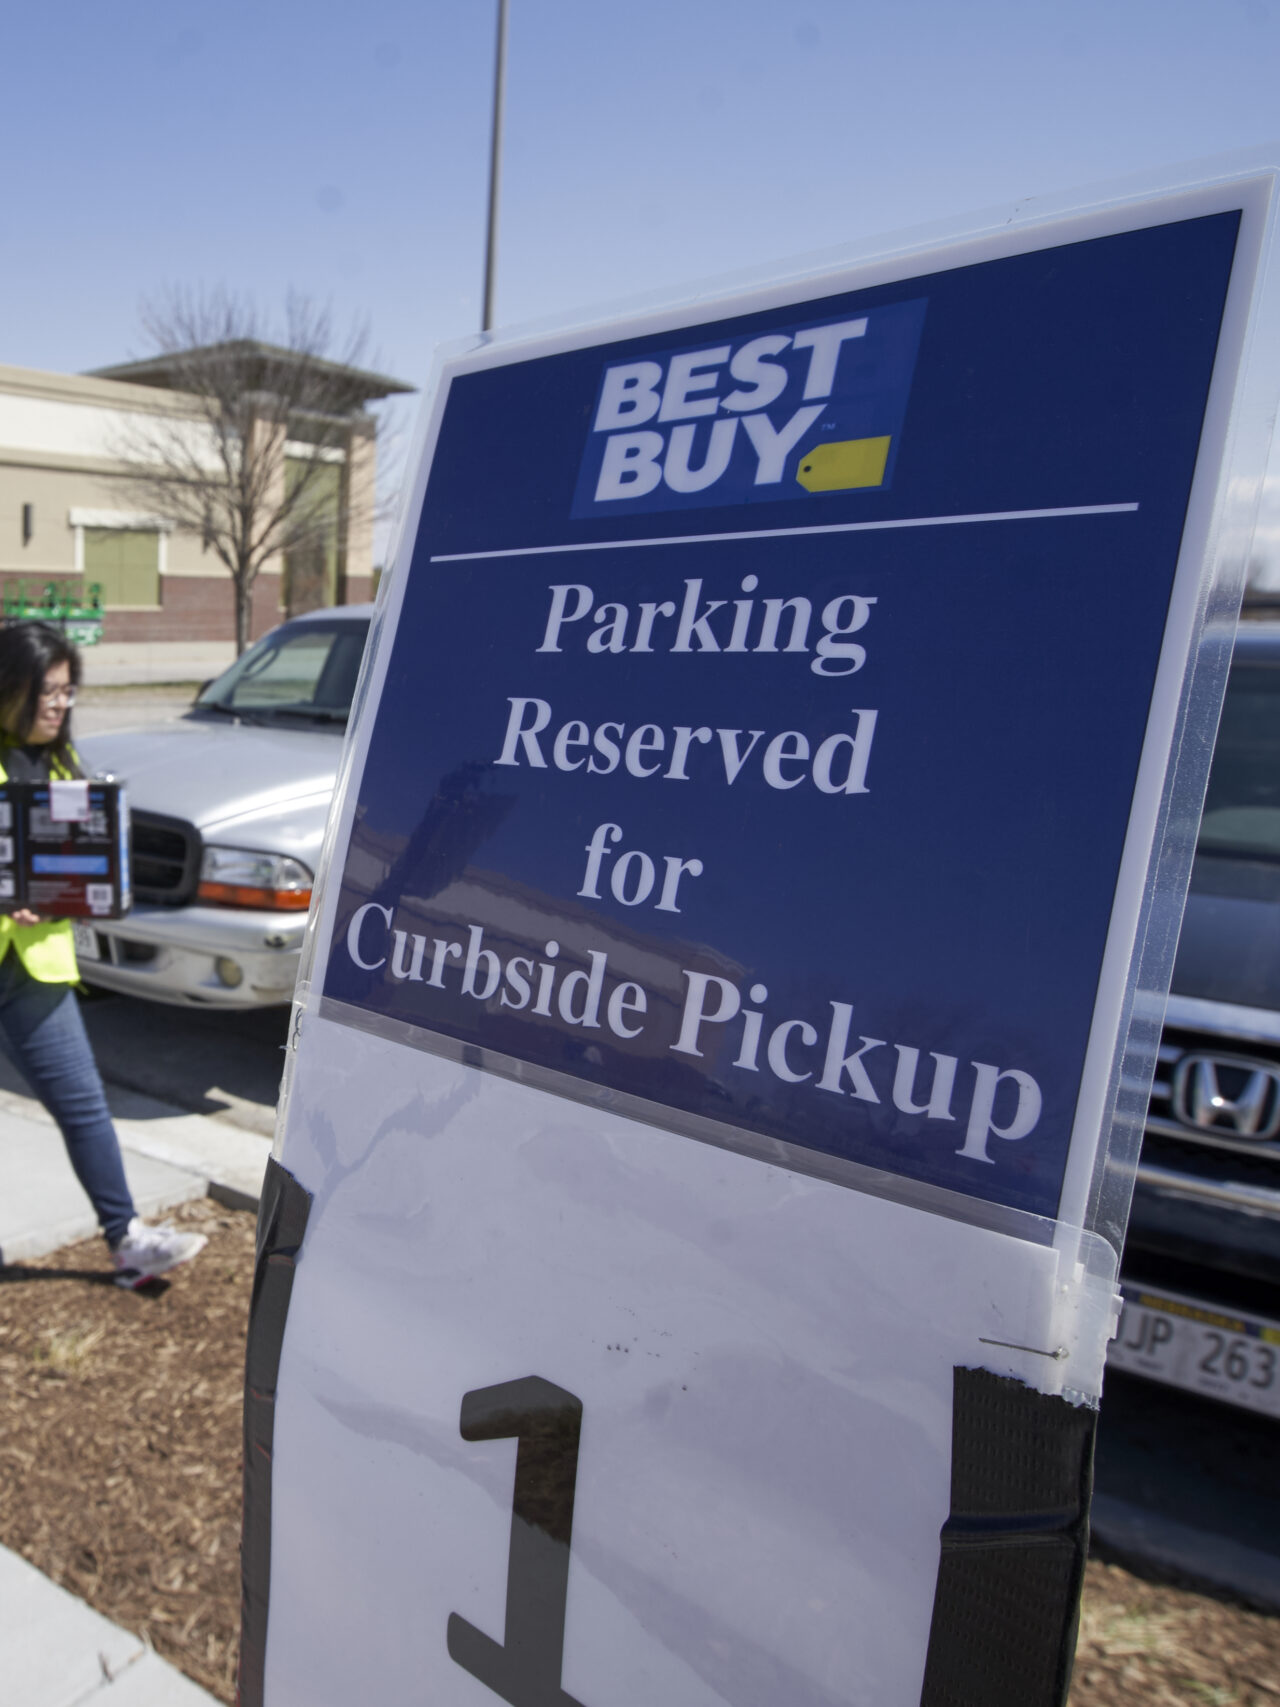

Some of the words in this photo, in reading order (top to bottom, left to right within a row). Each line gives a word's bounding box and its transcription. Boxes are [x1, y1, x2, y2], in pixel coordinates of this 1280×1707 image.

[593, 317, 868, 432] BEST
[594, 403, 828, 502] BUY
[534, 574, 878, 677] Parking
[494, 696, 879, 794] Reserved
[576, 823, 704, 914] for
[346, 902, 648, 1038] Curbside
[670, 969, 1043, 1165] Pickup
[1110, 1306, 1173, 1356] JP
[1199, 1330, 1276, 1390] 263
[447, 1374, 592, 1707] 1
